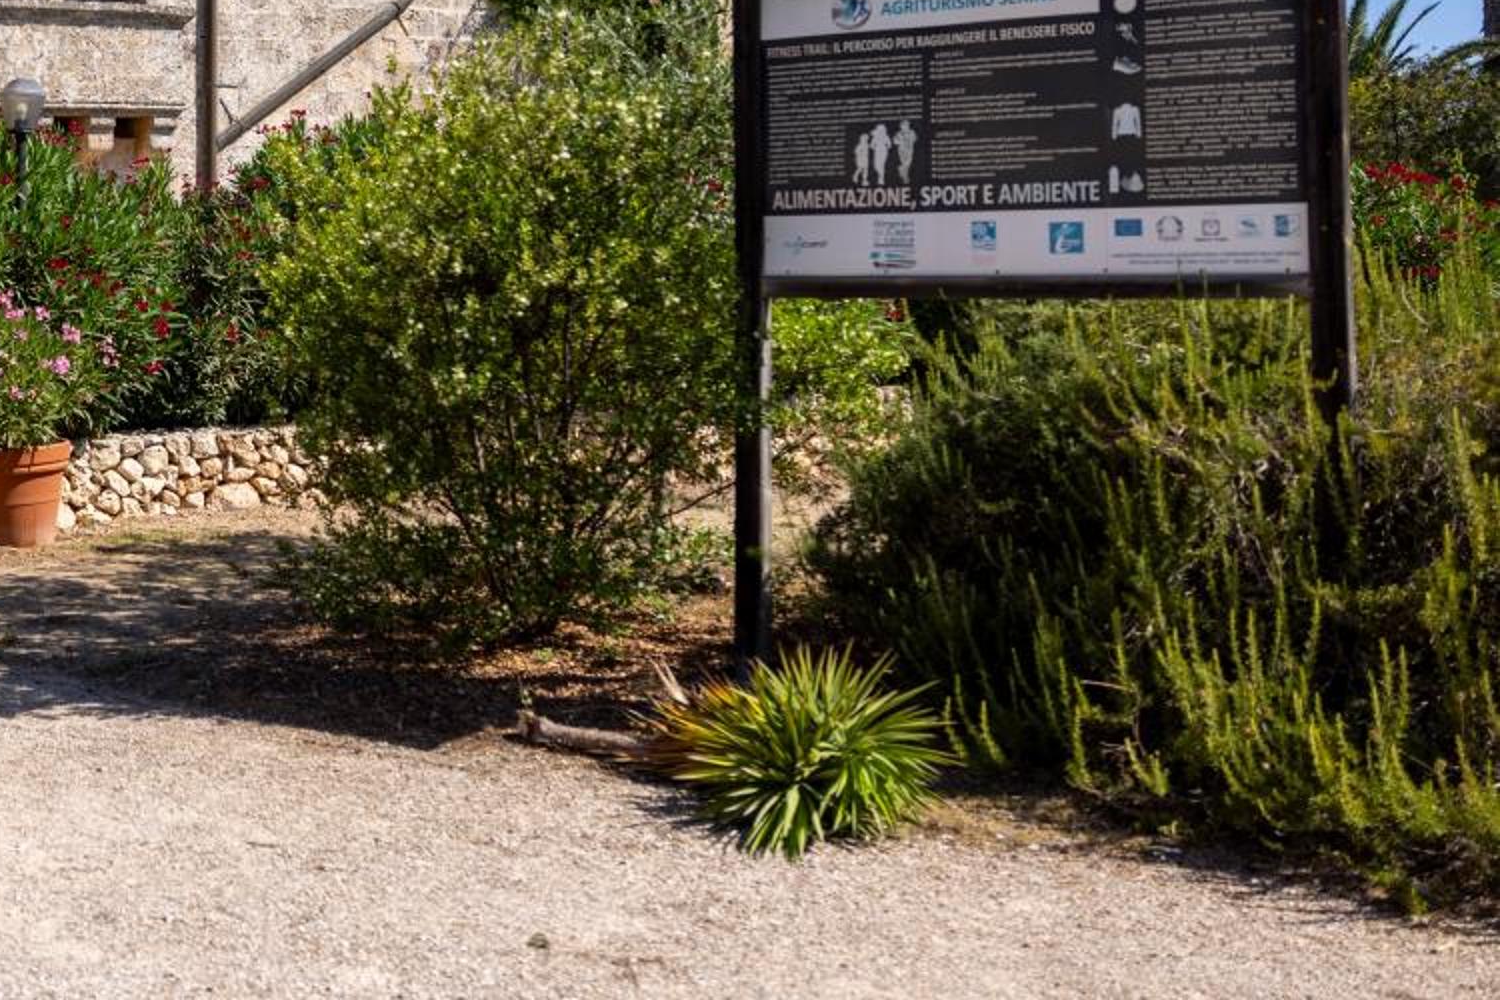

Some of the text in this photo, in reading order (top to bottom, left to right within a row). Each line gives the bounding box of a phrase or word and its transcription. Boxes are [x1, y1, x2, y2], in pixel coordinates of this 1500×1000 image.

[834, 41, 841, 53] IL
[843, 37, 894, 53] PERCORSO
[896, 36, 914, 49] PER
[916, 30, 987, 47] RAGGIUNGERE
[989, 28, 998, 41] IL
[1000, 25, 1057, 41] BENESSERE
[1060, 21, 1095, 35] FISICO
[772, 181, 1100, 211] ALIMENTAZIONE, SPORT E AMBIENTE
